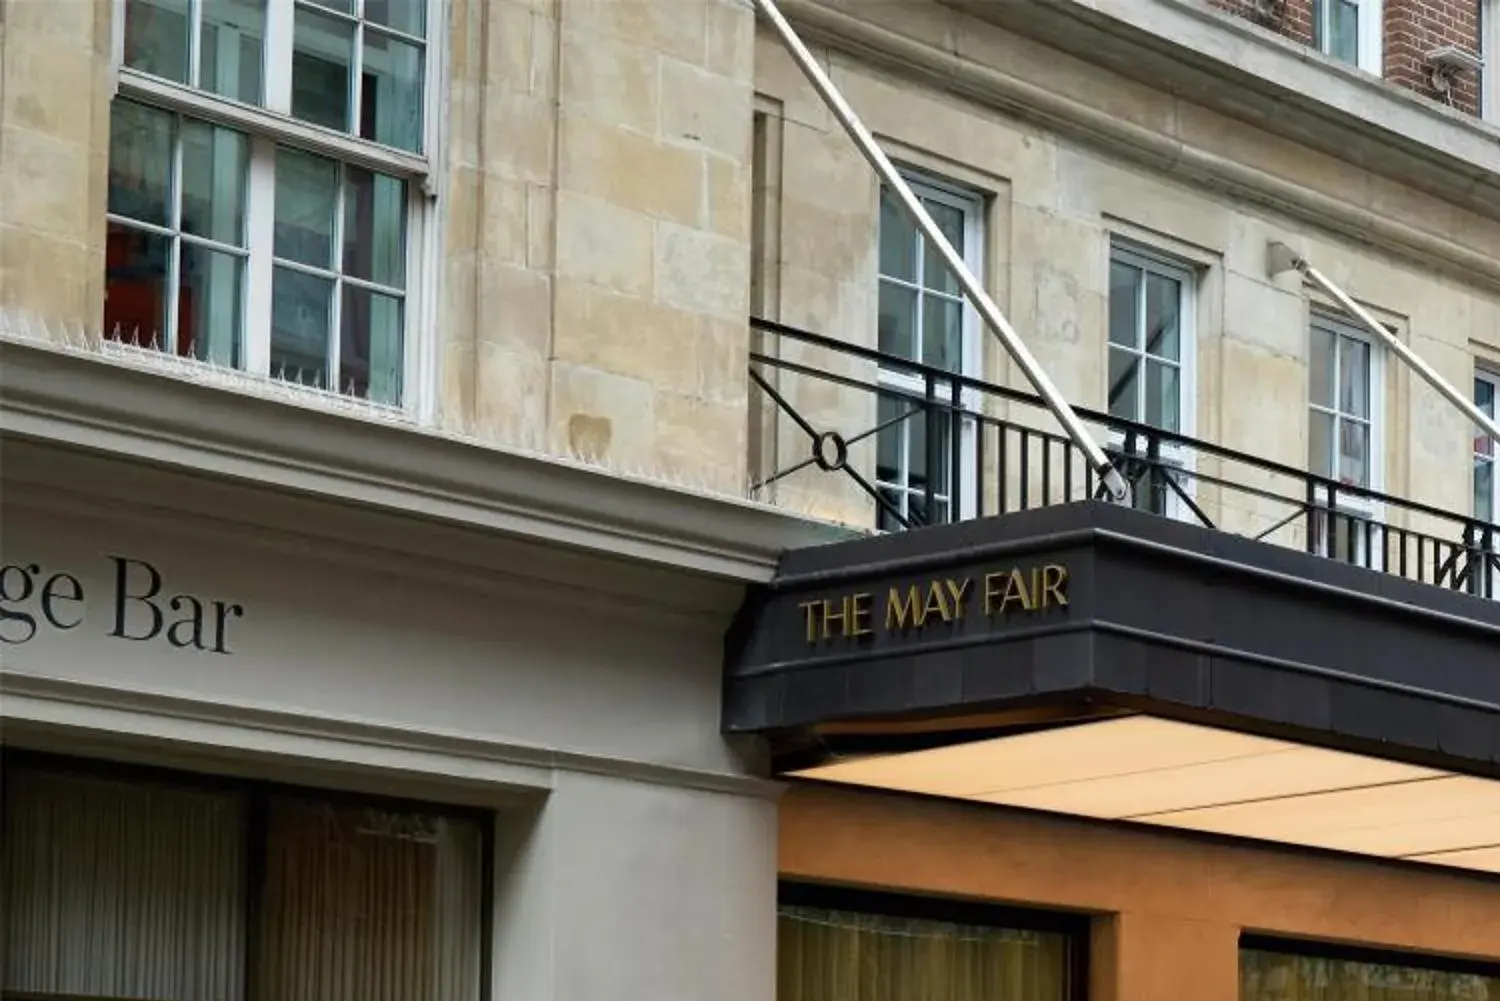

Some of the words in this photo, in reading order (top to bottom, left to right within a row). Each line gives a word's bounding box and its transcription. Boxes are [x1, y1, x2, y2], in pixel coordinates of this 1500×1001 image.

[0, 562, 84, 644] ge
[106, 555, 244, 655] Bar
[798, 592, 873, 642] THE
[884, 576, 971, 631] MAY
[984, 563, 1069, 616] FAIR
